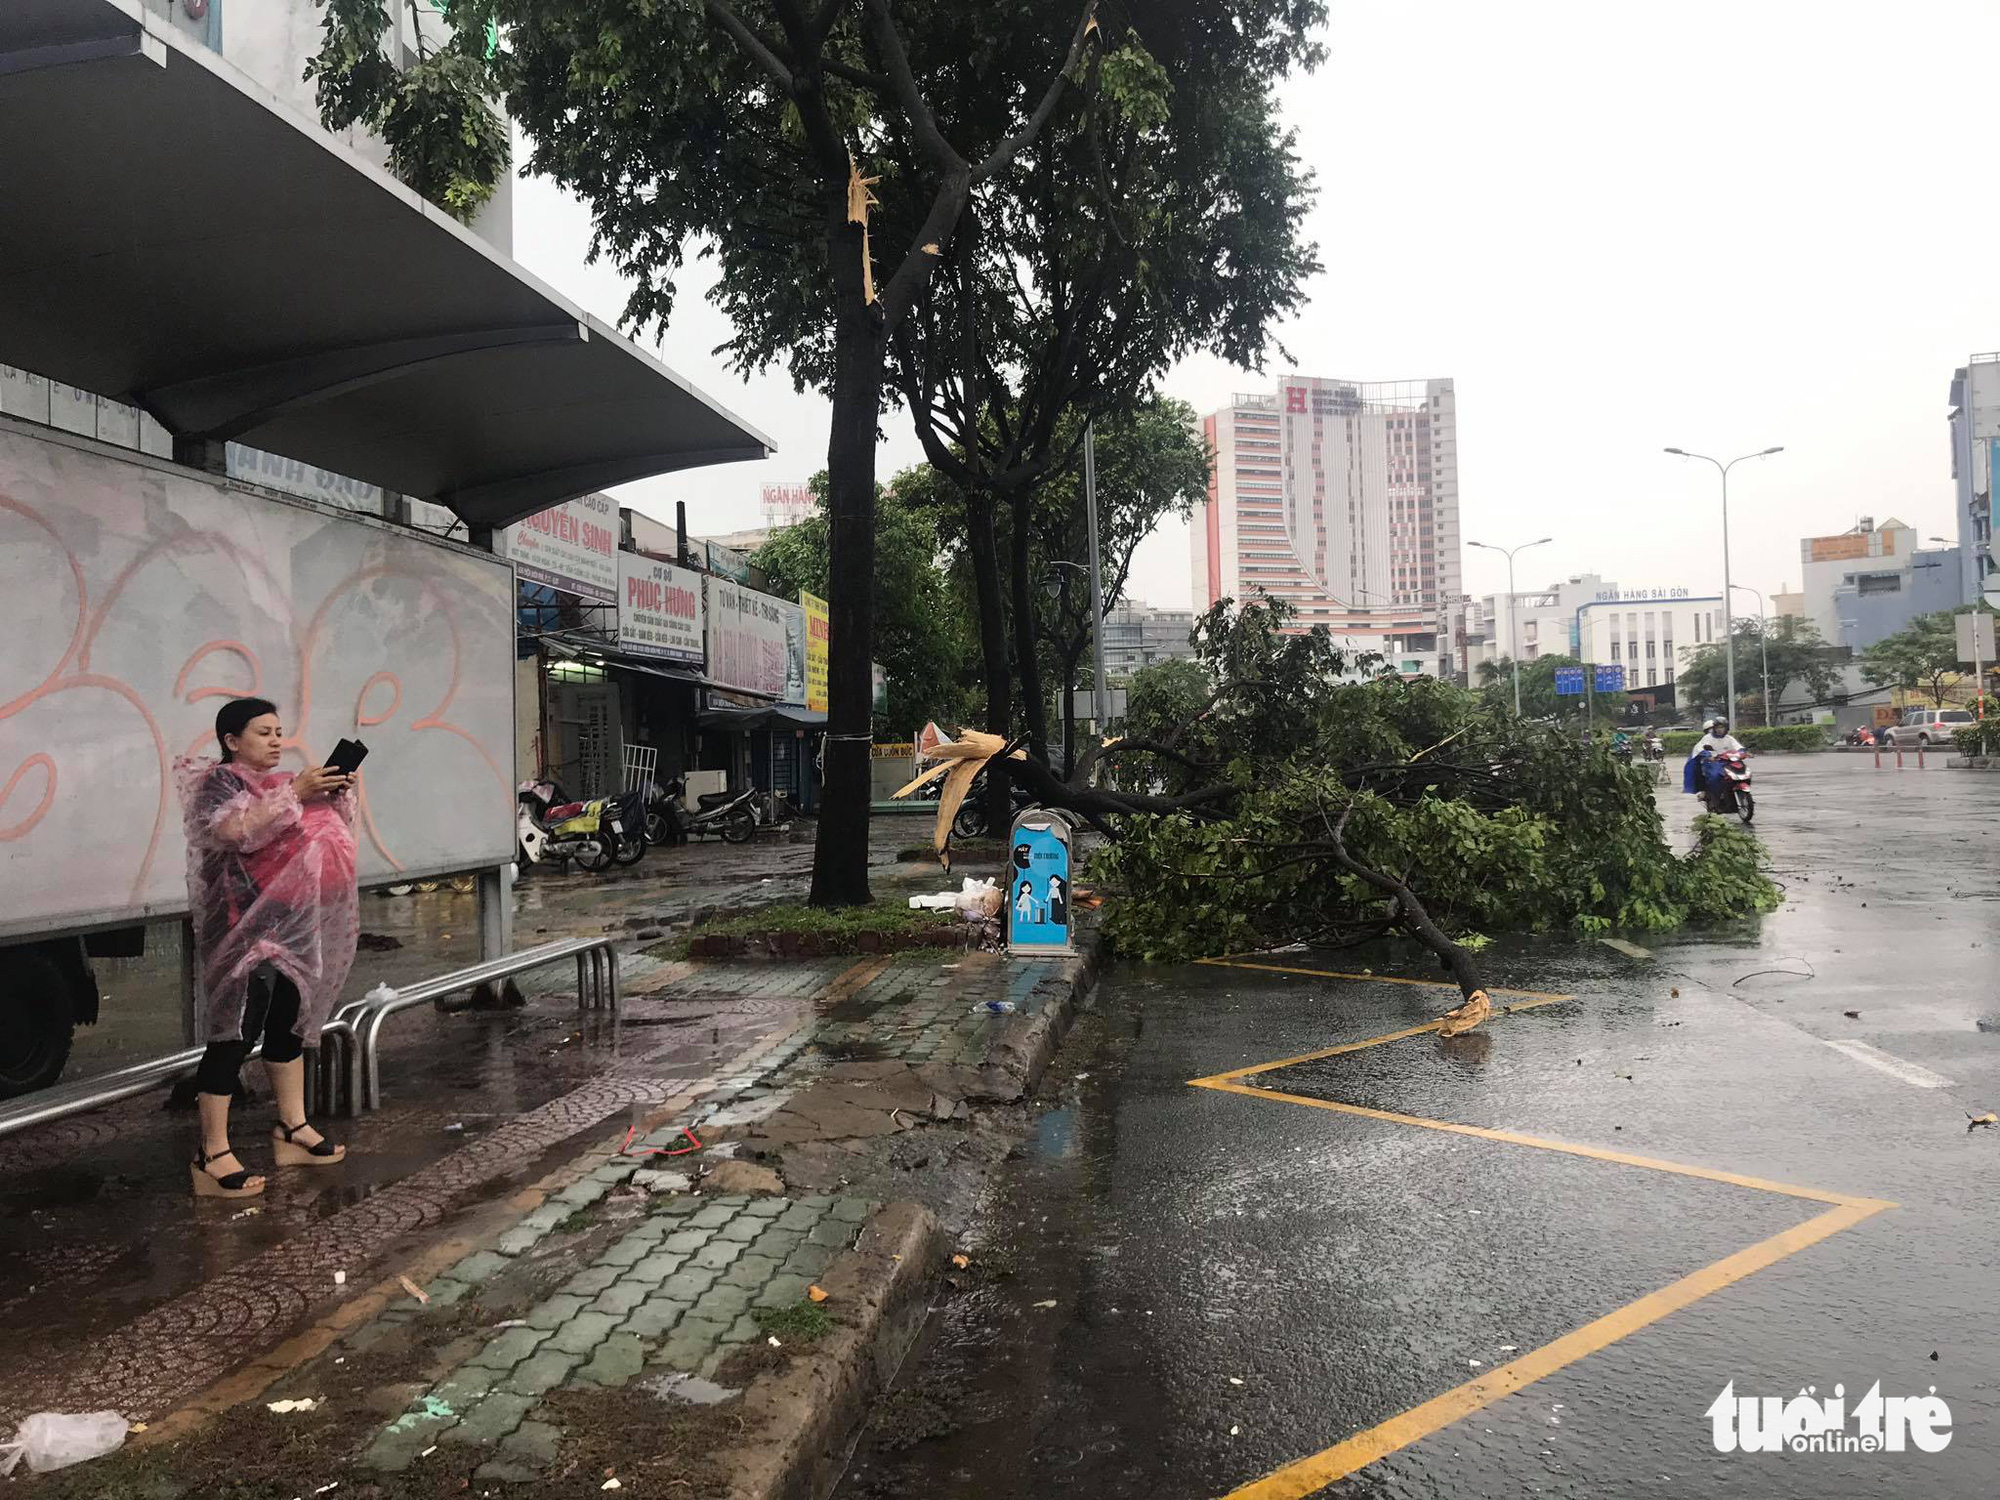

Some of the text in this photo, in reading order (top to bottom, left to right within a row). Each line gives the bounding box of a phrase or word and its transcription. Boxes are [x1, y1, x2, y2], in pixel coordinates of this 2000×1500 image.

[627, 575, 662, 613] PHÚC
[665, 585, 696, 620] HƯNG
[1596, 585, 1689, 600] NGÂN HÀNG SÀI GÒN
